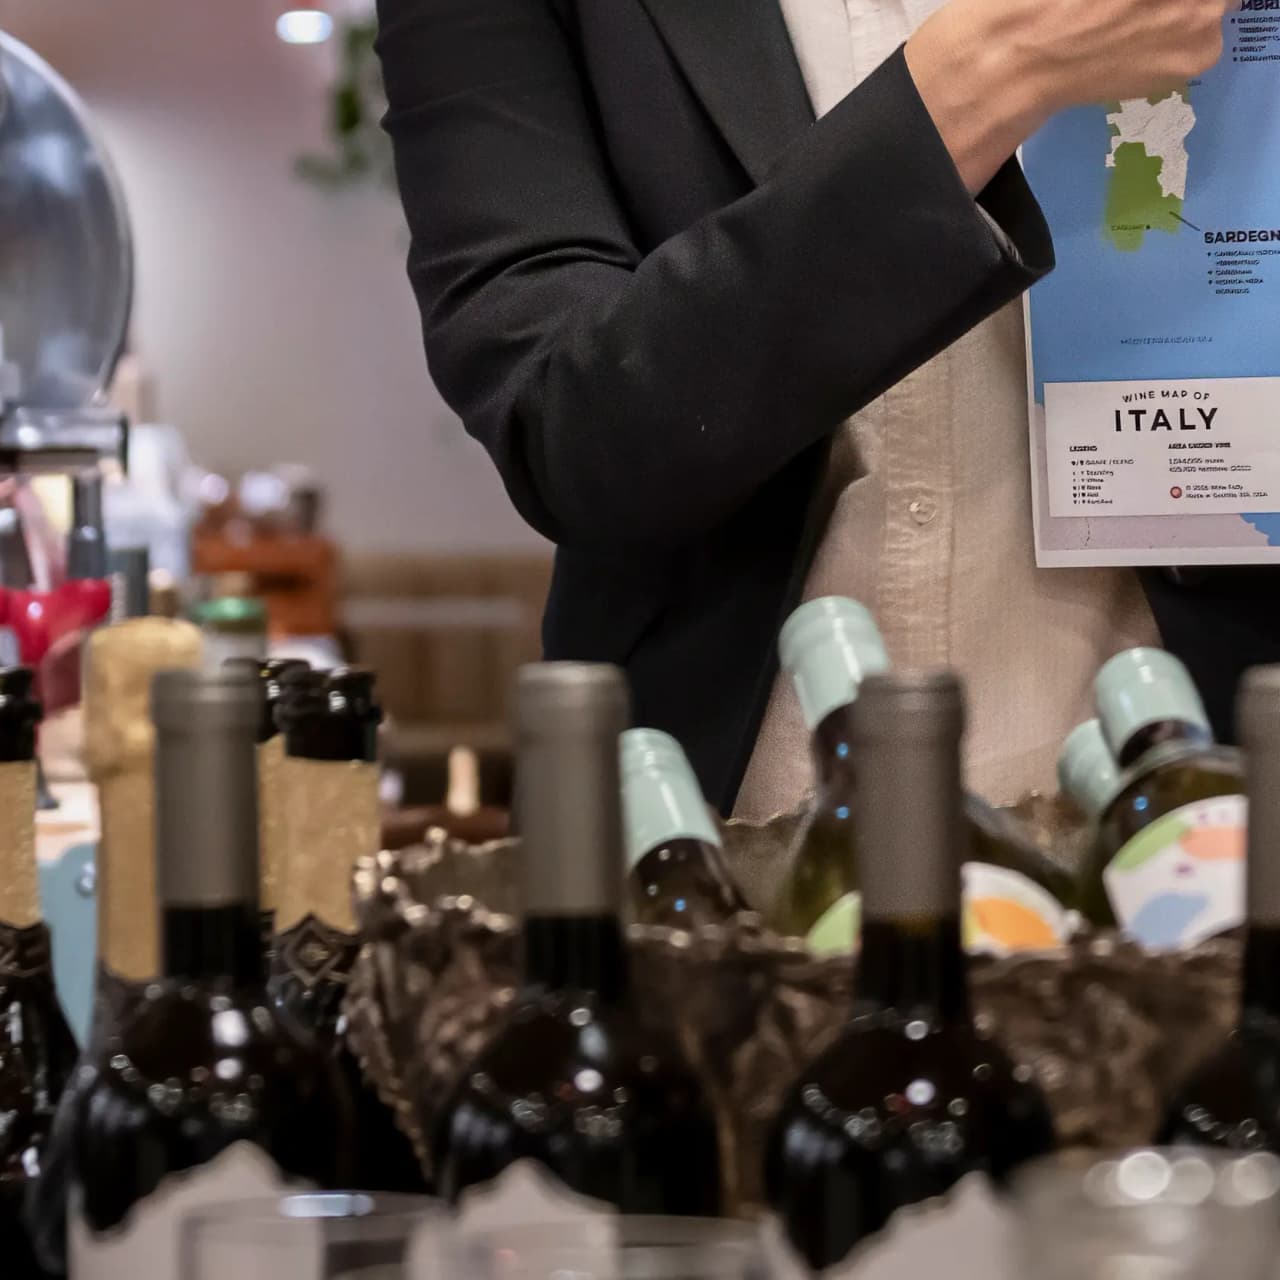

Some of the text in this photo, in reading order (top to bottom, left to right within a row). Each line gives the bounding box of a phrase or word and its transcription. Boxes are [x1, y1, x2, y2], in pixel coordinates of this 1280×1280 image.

[1122, 390, 1210, 403] WINE MAP OF
[1114, 407, 1218, 432] ITALY
